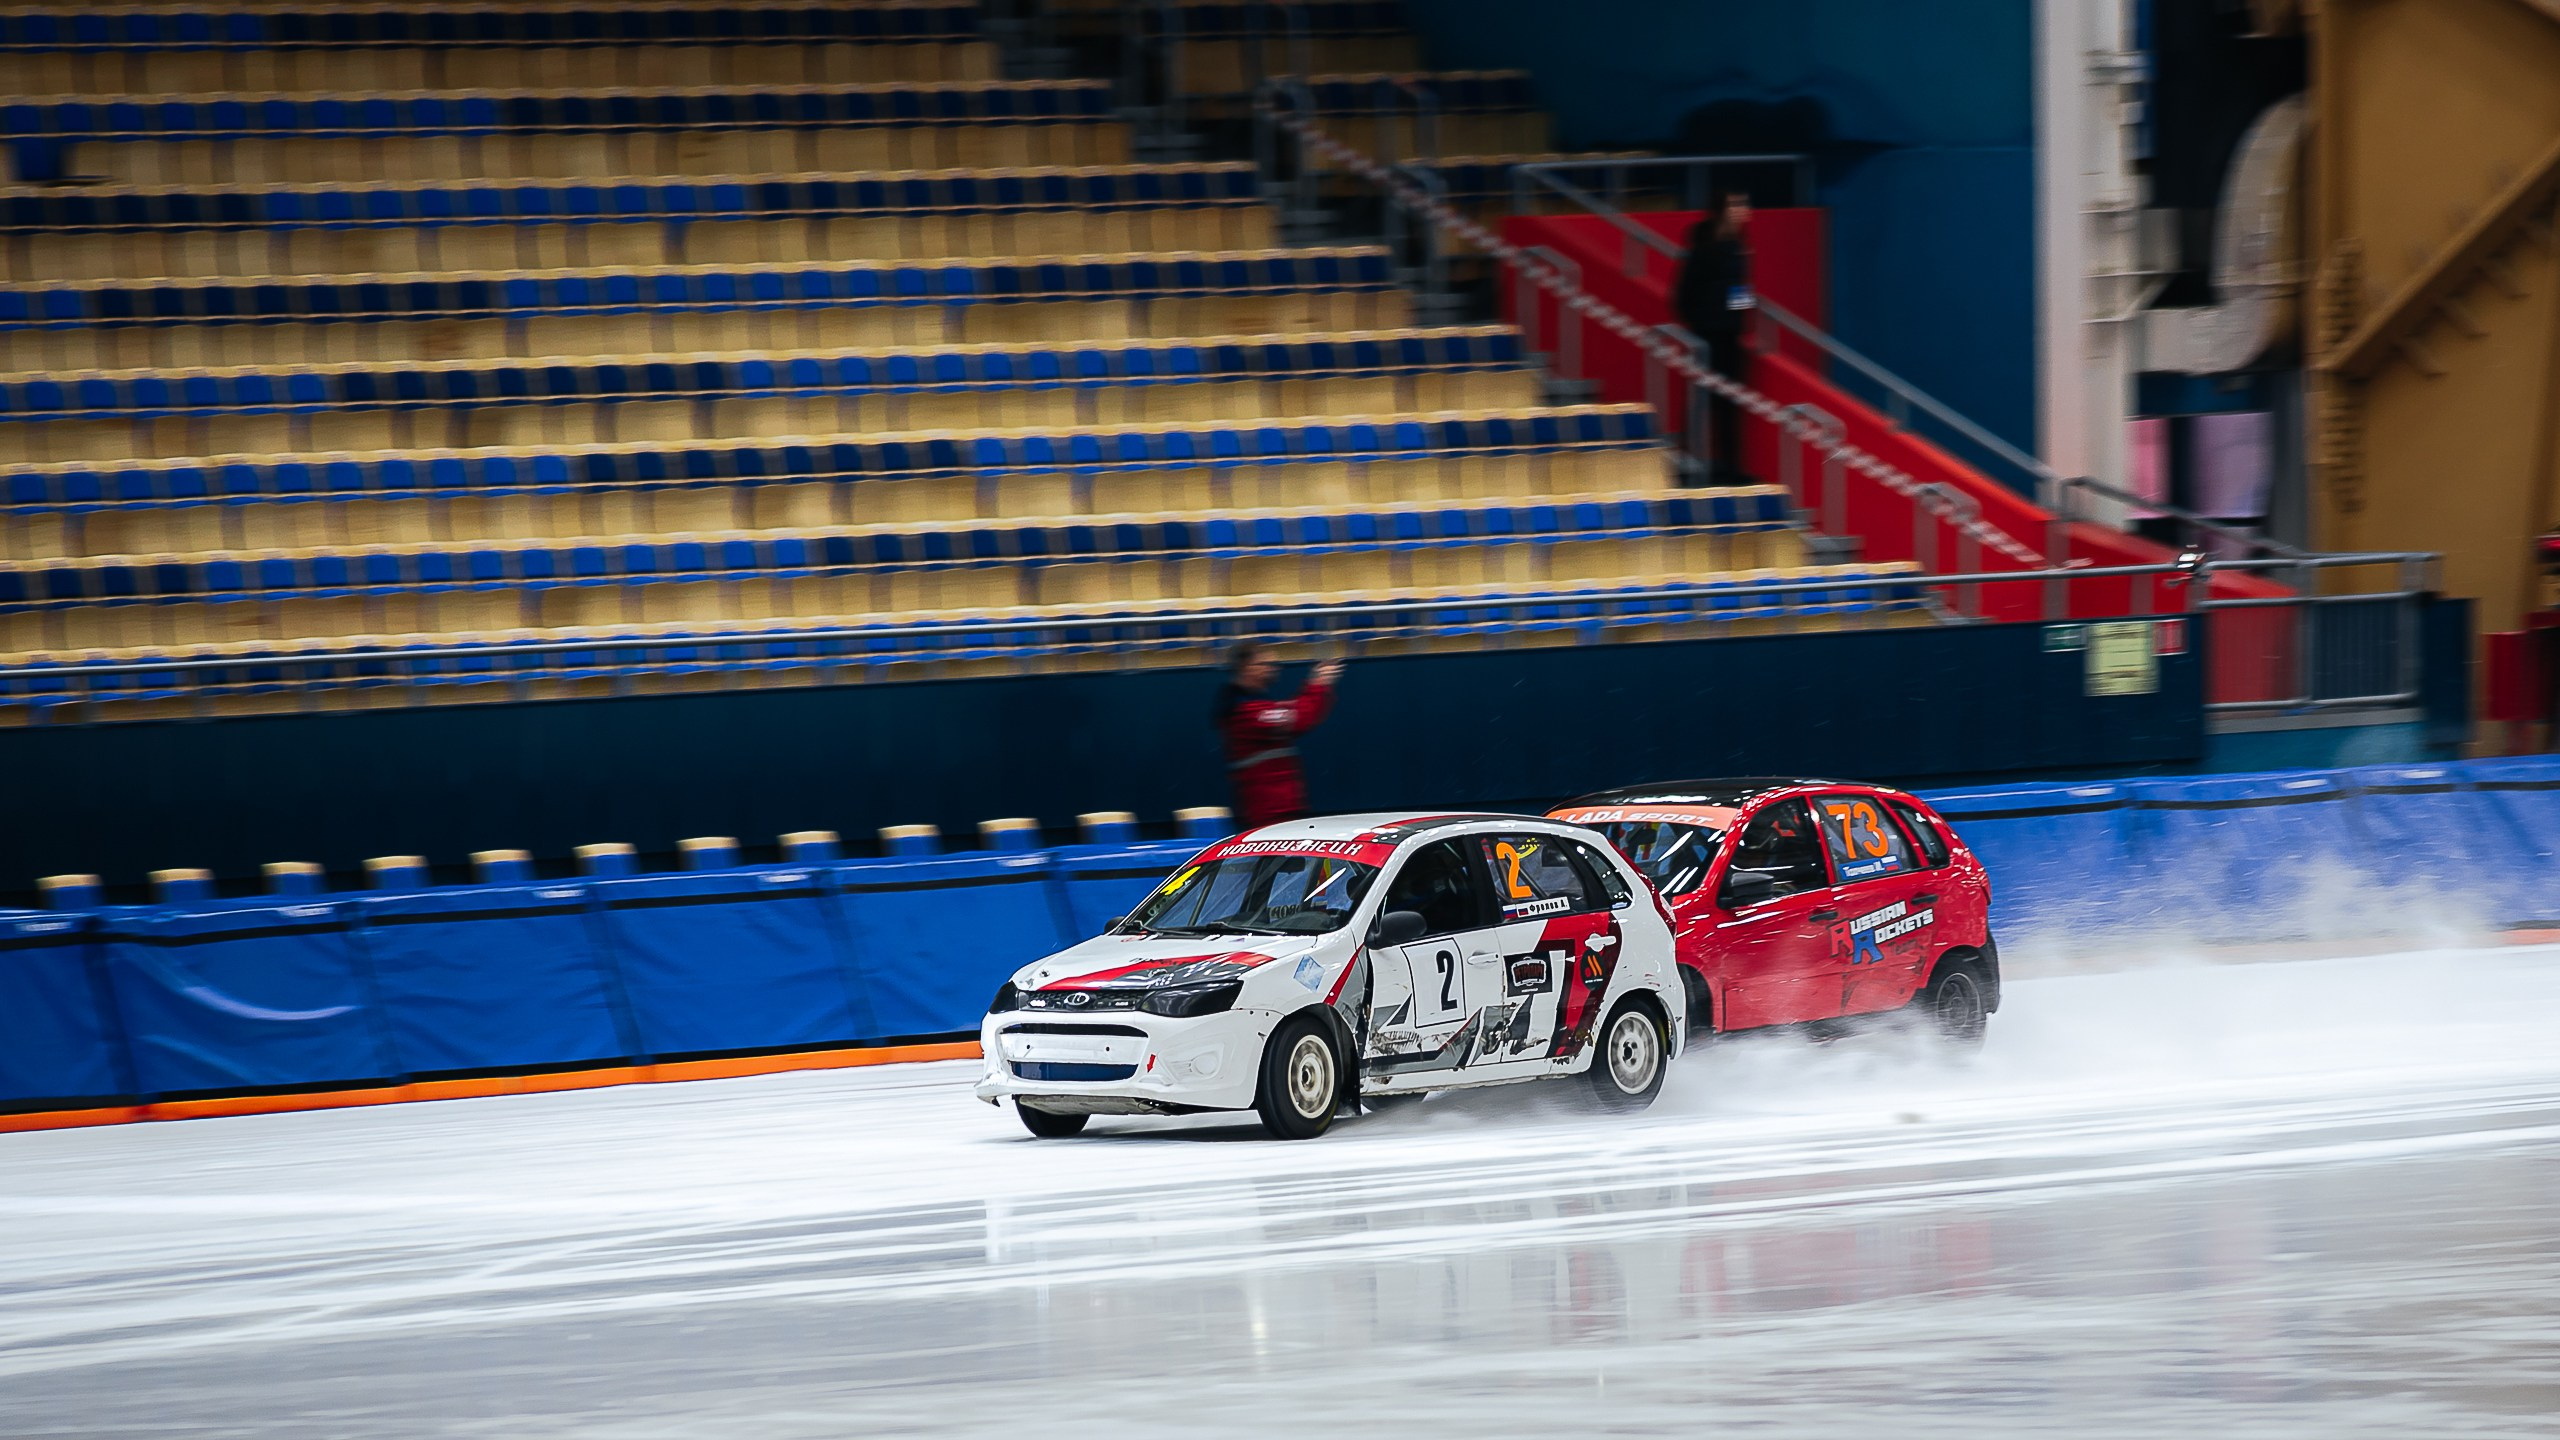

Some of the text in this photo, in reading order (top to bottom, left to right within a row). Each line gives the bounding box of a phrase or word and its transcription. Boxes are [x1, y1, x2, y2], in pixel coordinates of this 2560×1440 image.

[1565, 810, 1715, 825] LADA SPORT
[1825, 802, 1889, 859] 73
[1216, 840, 1363, 857] НОВОКУЗНЕЦК
[1495, 842, 1532, 898] 2
[1830, 900, 1907, 957] RUSSIAN
[1852, 908, 1934, 965] ROCKETS
[1436, 950, 1458, 1011] 2
